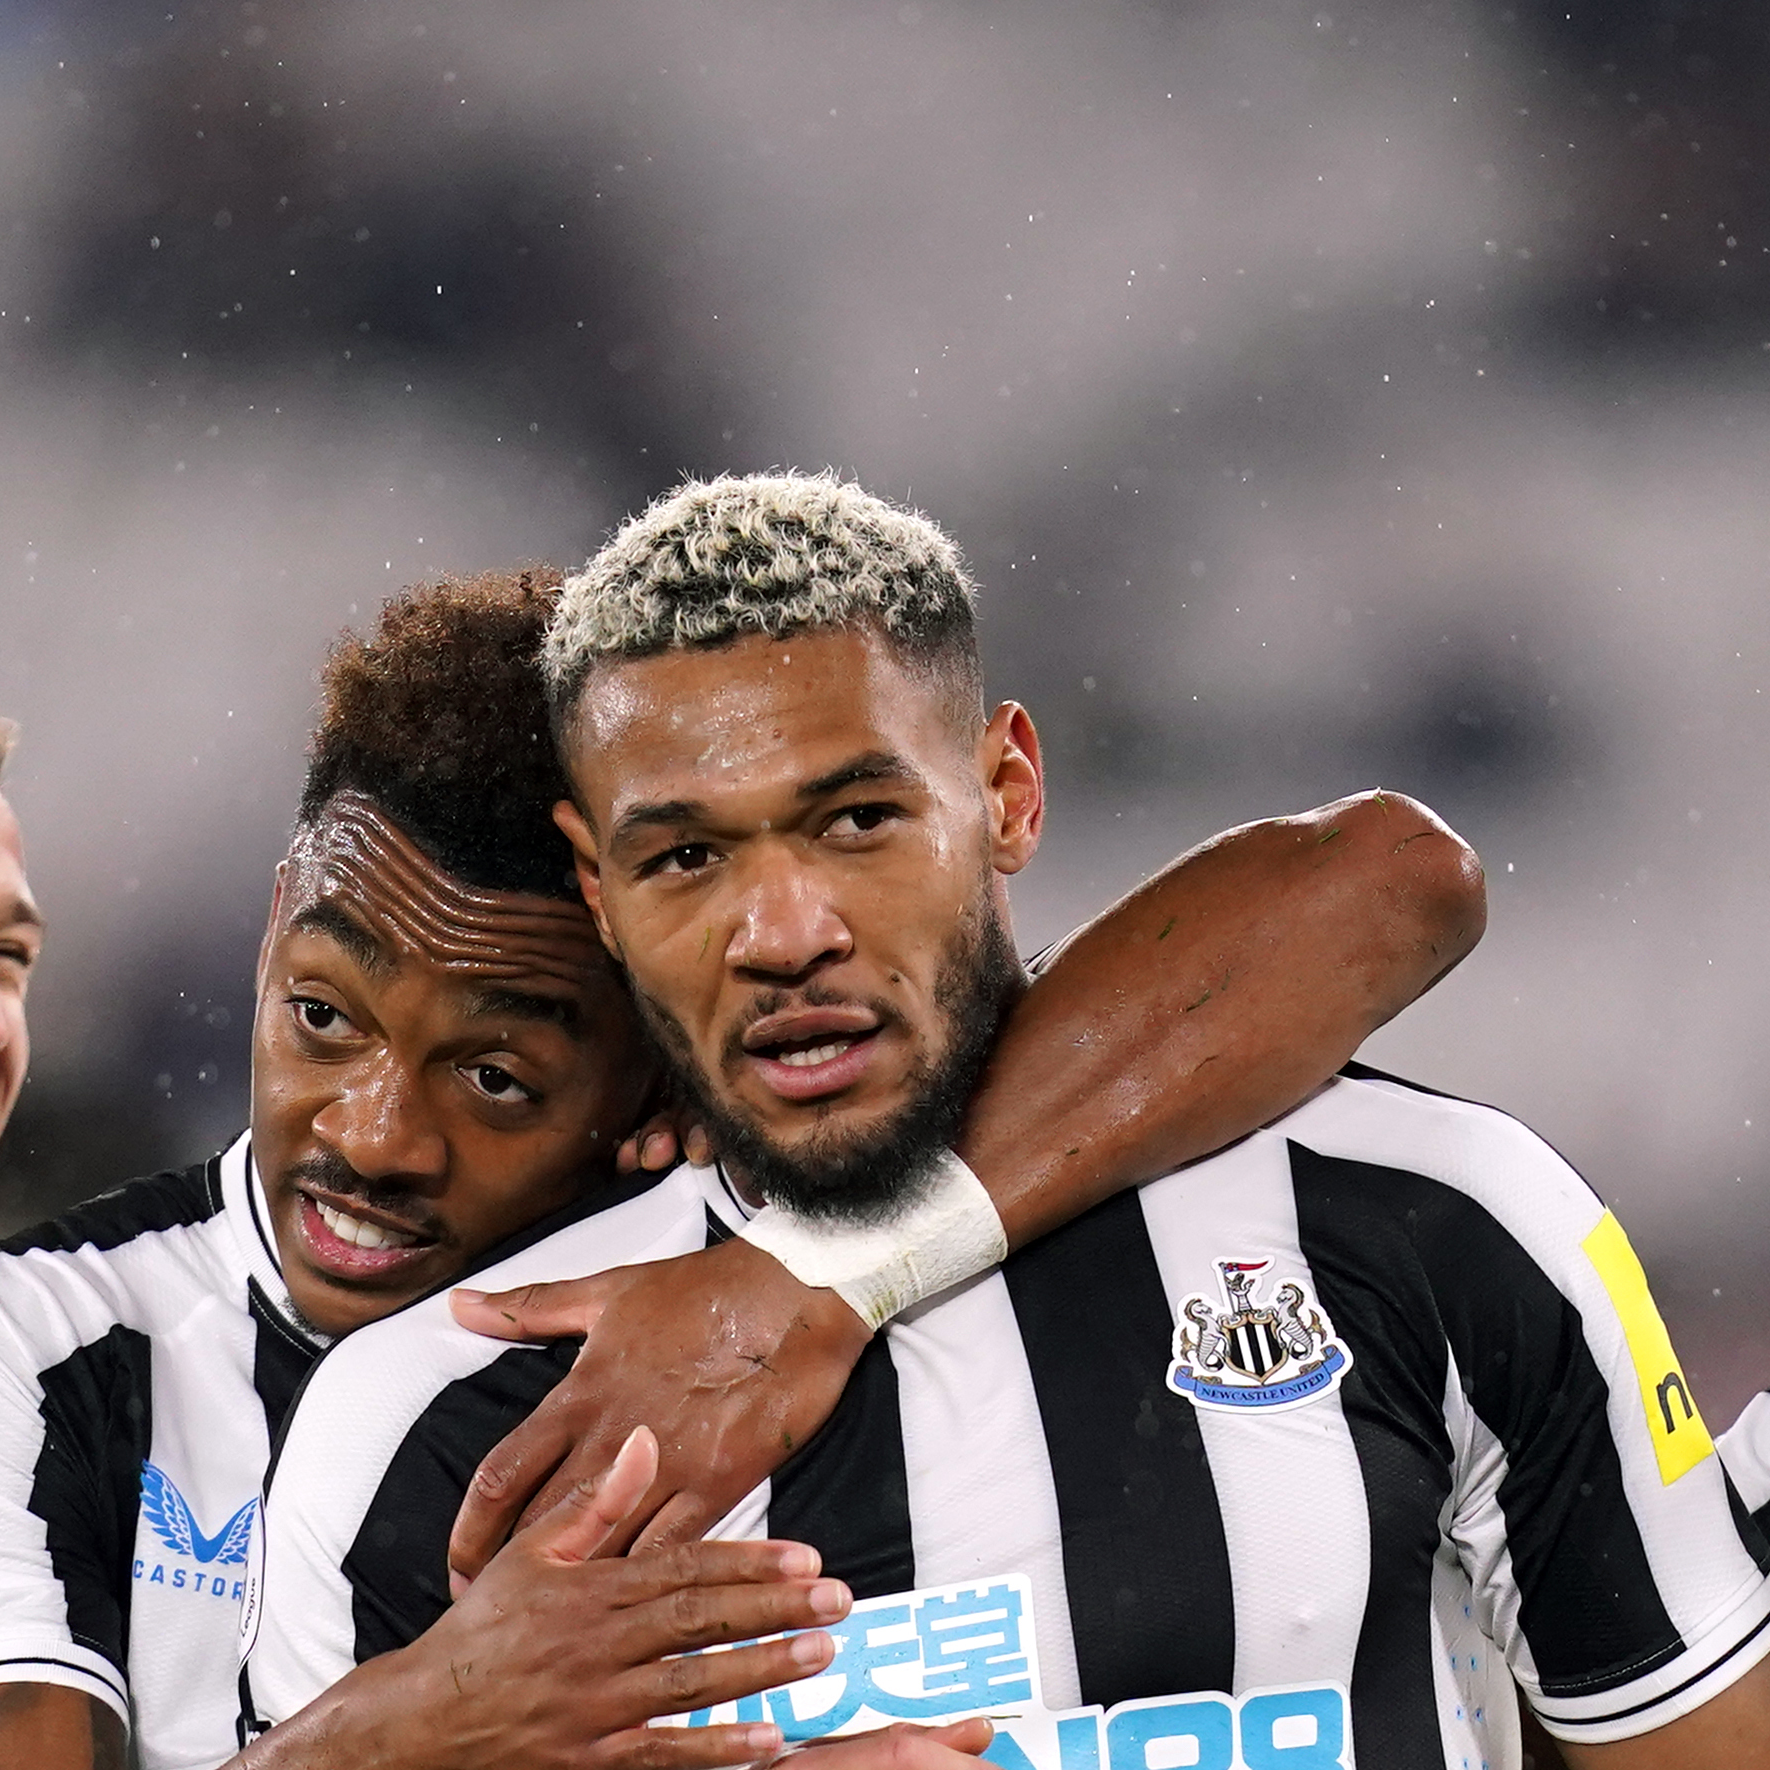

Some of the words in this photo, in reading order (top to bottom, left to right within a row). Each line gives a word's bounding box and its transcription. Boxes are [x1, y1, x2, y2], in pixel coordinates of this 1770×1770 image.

[1201, 1387, 1279, 1401] NEWCASTLE
[1280, 1372, 1325, 1397] UNITED
[132, 1559, 244, 1600] CASTOR
